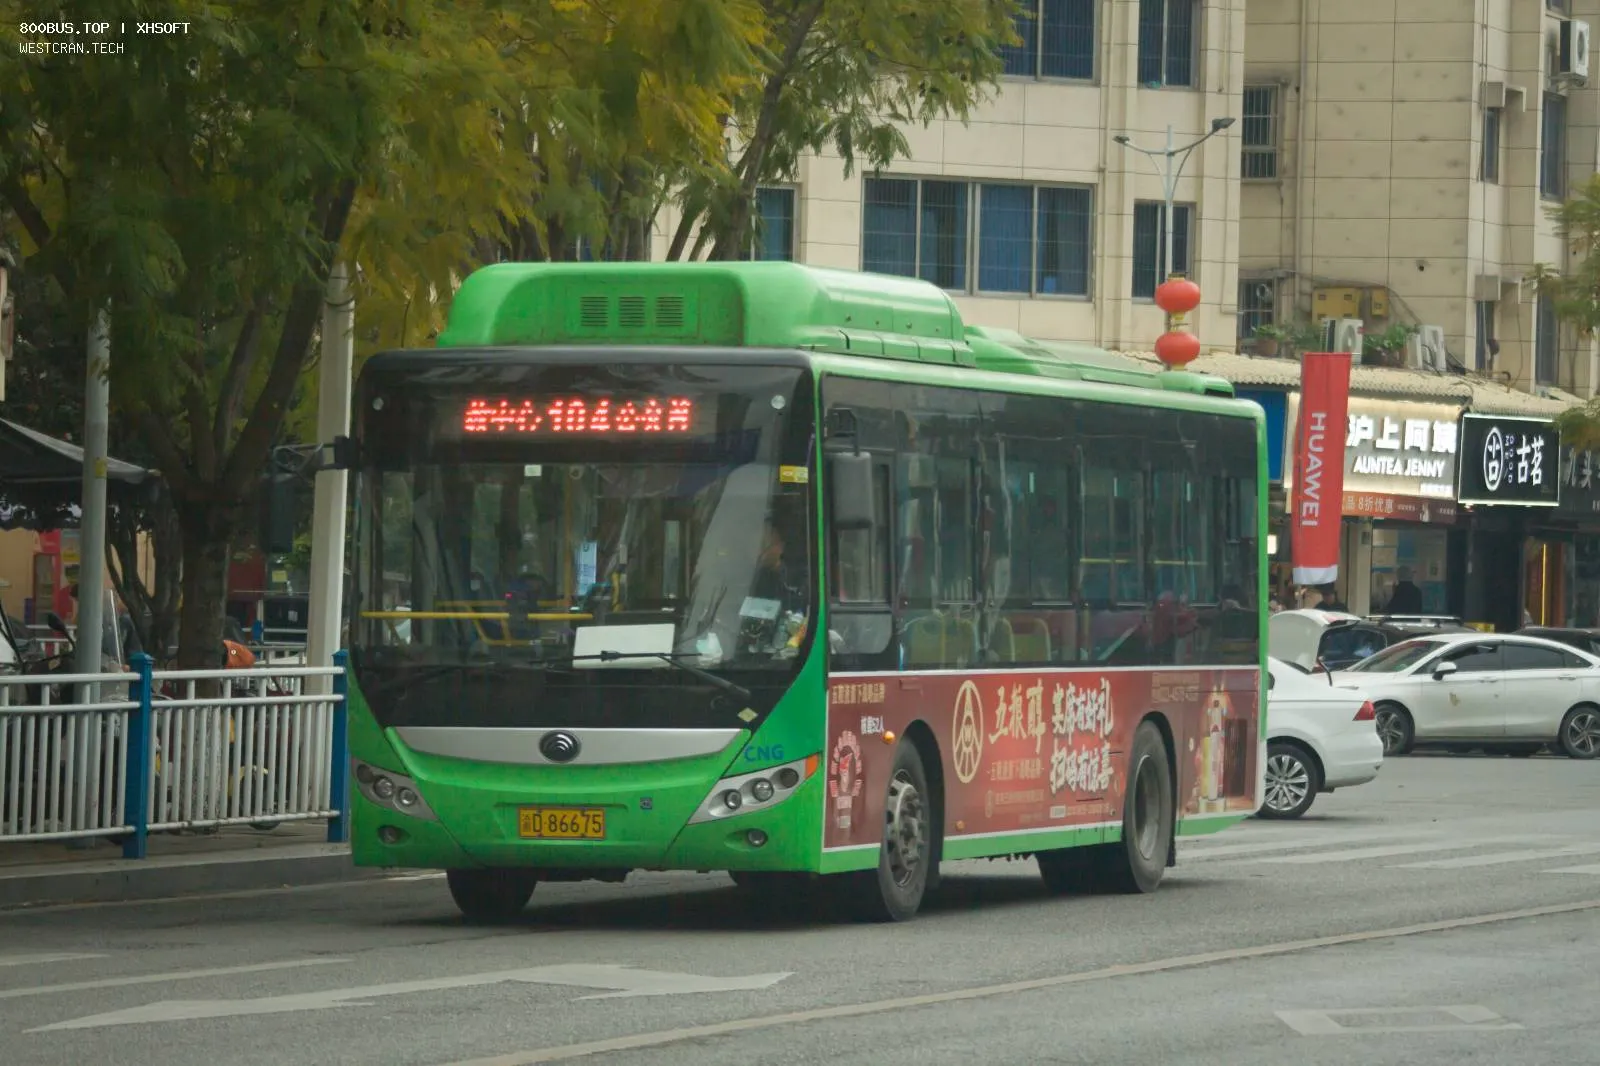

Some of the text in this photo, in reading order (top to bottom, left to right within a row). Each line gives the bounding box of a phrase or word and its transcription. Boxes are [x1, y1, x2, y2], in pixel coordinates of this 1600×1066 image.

[1302, 412, 1327, 527] HUAWEI
[1353, 455, 1446, 478] AUNTEA JENNY
[1516, 434, 1545, 487] 古茗
[743, 743, 785, 761] CNG
